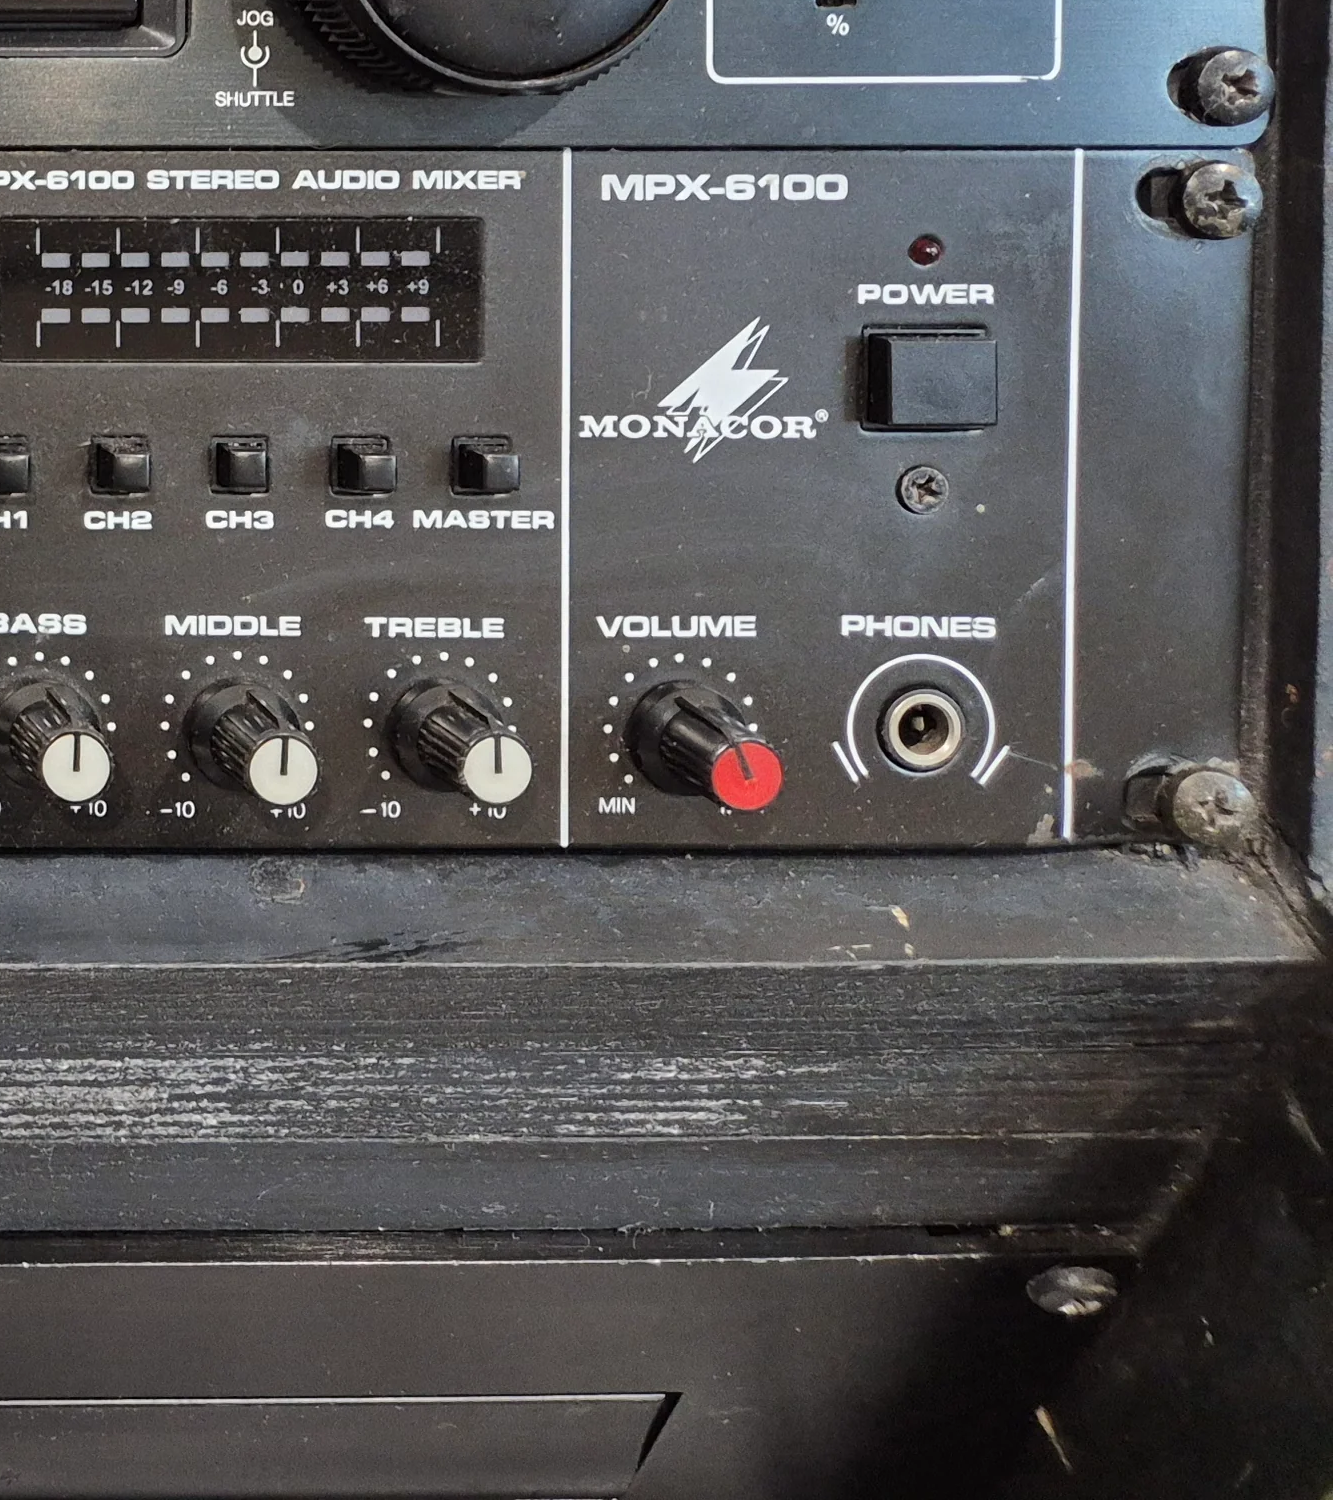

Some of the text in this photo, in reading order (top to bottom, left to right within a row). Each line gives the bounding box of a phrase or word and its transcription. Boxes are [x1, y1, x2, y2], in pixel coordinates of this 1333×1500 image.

[236, 9, 274, 27] JOG
[214, 90, 295, 108] SHUTTLE
[146, 169, 280, 190] STEREO
[291, 169, 400, 190] AUDIO
[412, 169, 526, 190] MIXER
[601, 173, 849, 201] MPX-6100
[45, 279, 73, 296] -18
[84, 279, 113, 296] -15
[124, 279, 153, 296] -12
[166, 279, 185, 295] -9
[210, 279, 228, 296] -6
[251, 278, 271, 295] -3
[326, 278, 350, 296] +3
[365, 278, 389, 295] +6
[406, 276, 430, 295] +9
[857, 283, 995, 305] POWER
[83, 510, 153, 530] CH2
[205, 510, 275, 530] CH3
[324, 509, 395, 529] CH4
[412, 509, 555, 530] MASTER
[164, 614, 302, 637] MIDDLE
[363, 616, 505, 639] TREBLE
[595, 615, 757, 638] VOLUME
[841, 614, 997, 639] PHONES
[598, 796, 636, 815] MIN
